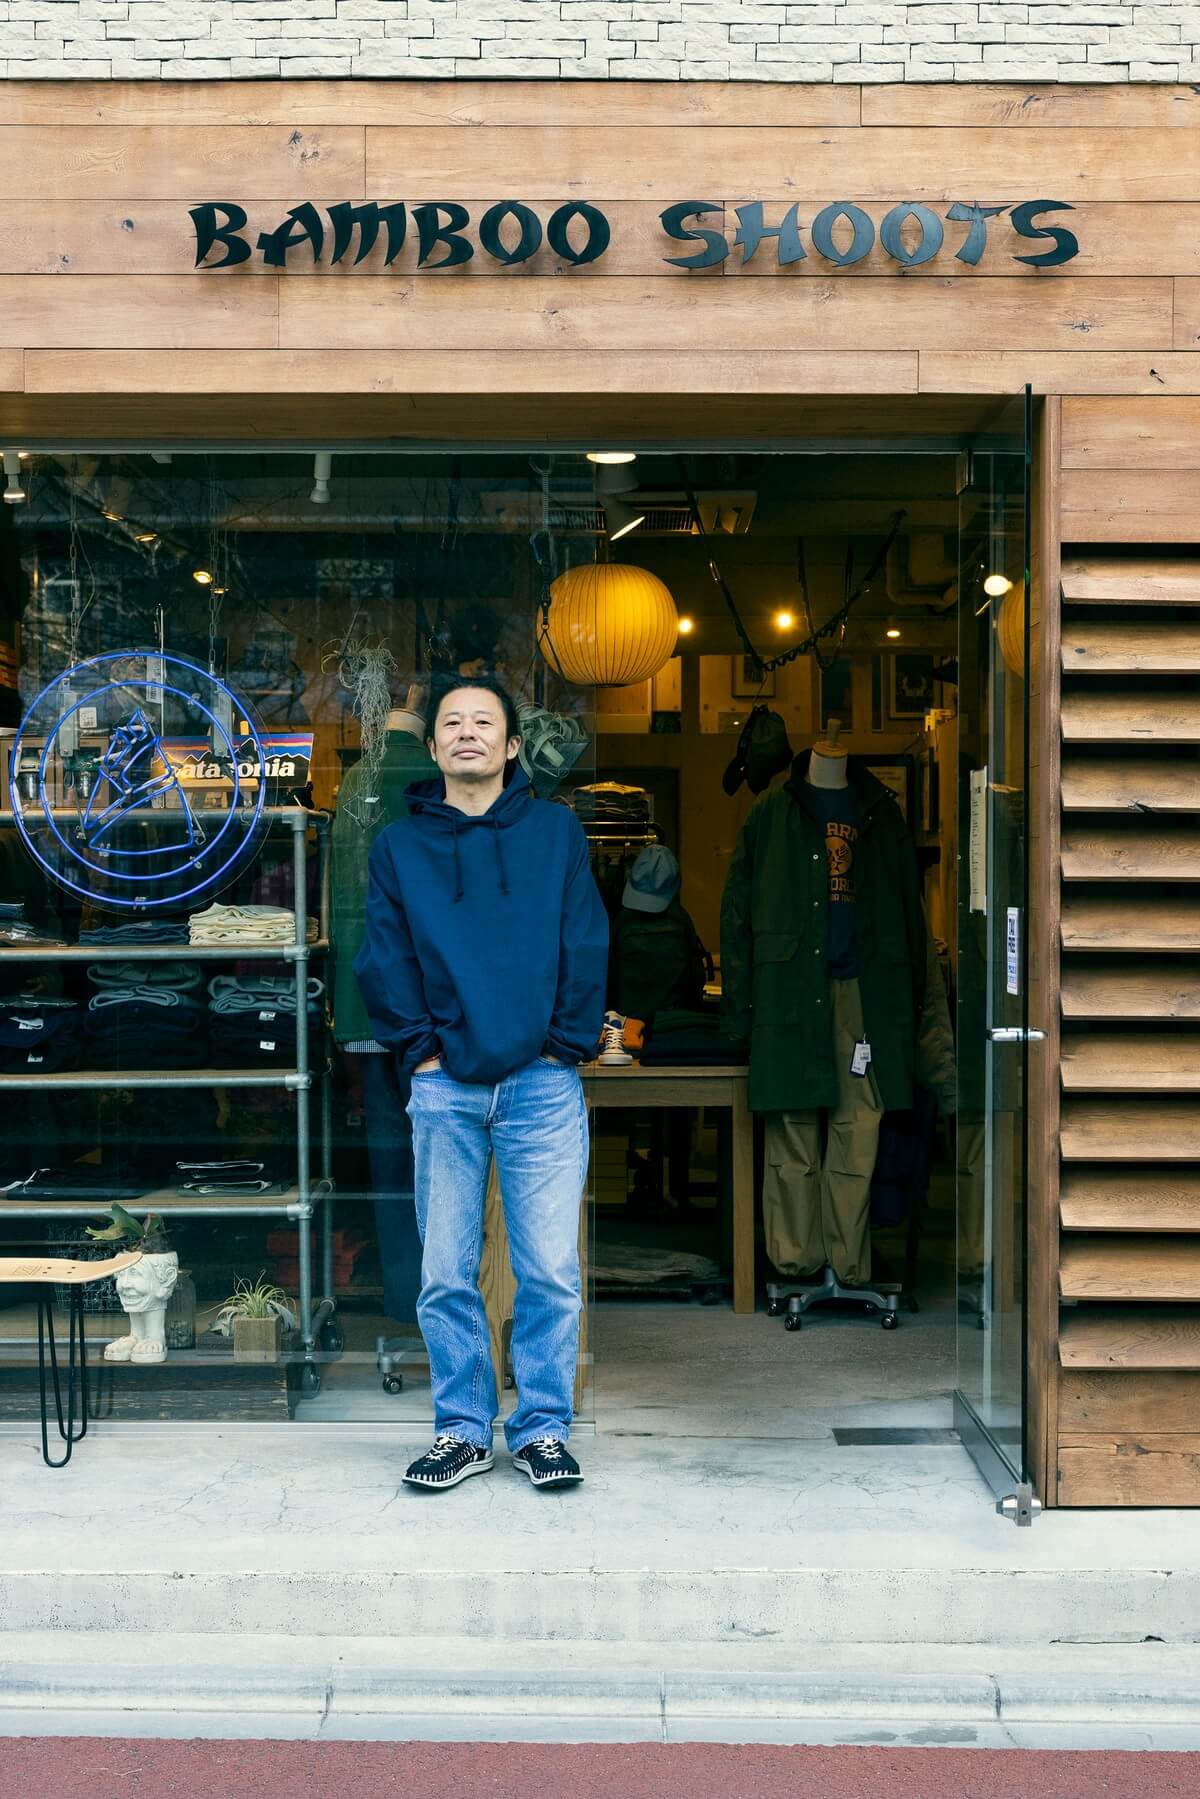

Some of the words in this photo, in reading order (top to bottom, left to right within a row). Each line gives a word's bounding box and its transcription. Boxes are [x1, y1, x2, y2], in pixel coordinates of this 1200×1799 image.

[188, 200, 611, 269] BAMBOO
[658, 200, 1081, 267] SHOOTS
[163, 758, 295, 782] ataonia
